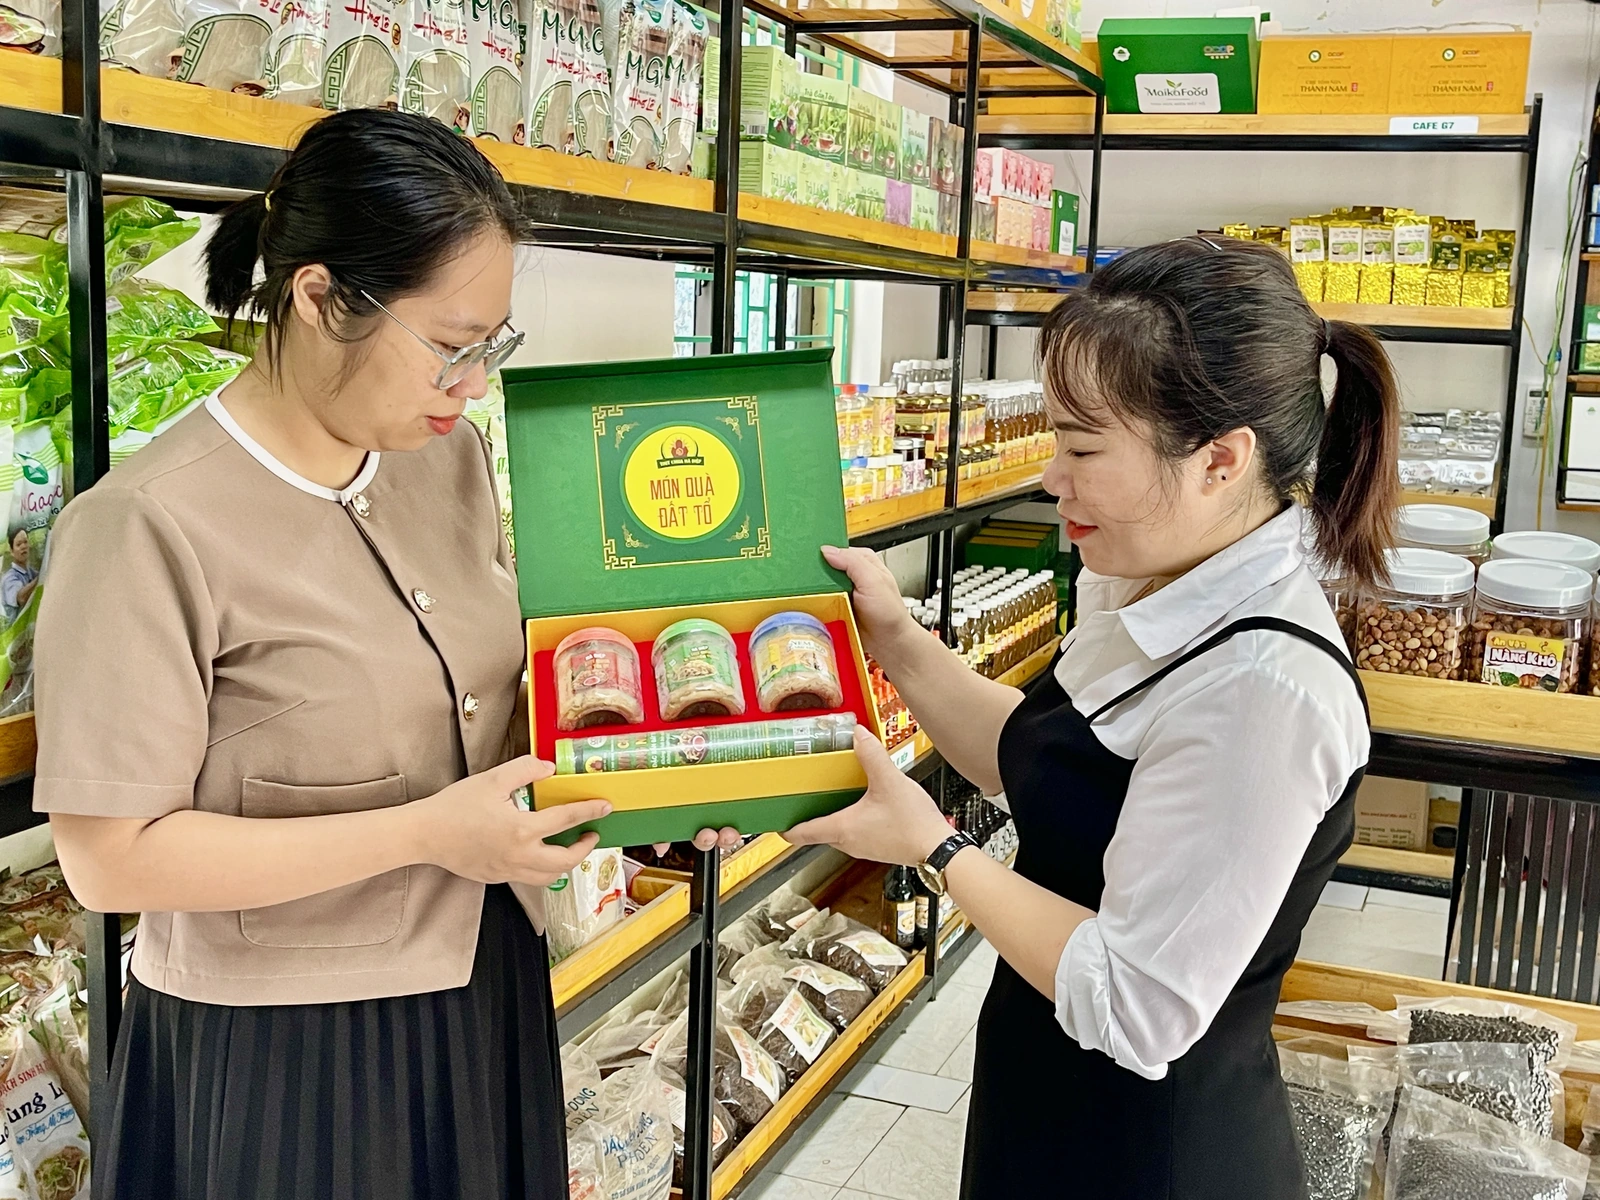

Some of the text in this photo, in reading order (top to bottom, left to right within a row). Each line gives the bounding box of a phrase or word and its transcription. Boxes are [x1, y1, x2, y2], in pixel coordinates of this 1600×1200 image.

[1412, 121, 1455, 130] CAFE G7
[650, 473, 715, 500] MÓN QUÀ
[657, 498, 713, 528] ĐẤT TỔ
[1526, 651, 1557, 667] KHÔ
[6, 1092, 47, 1124] ùng
[48, 1081, 64, 1100] L
